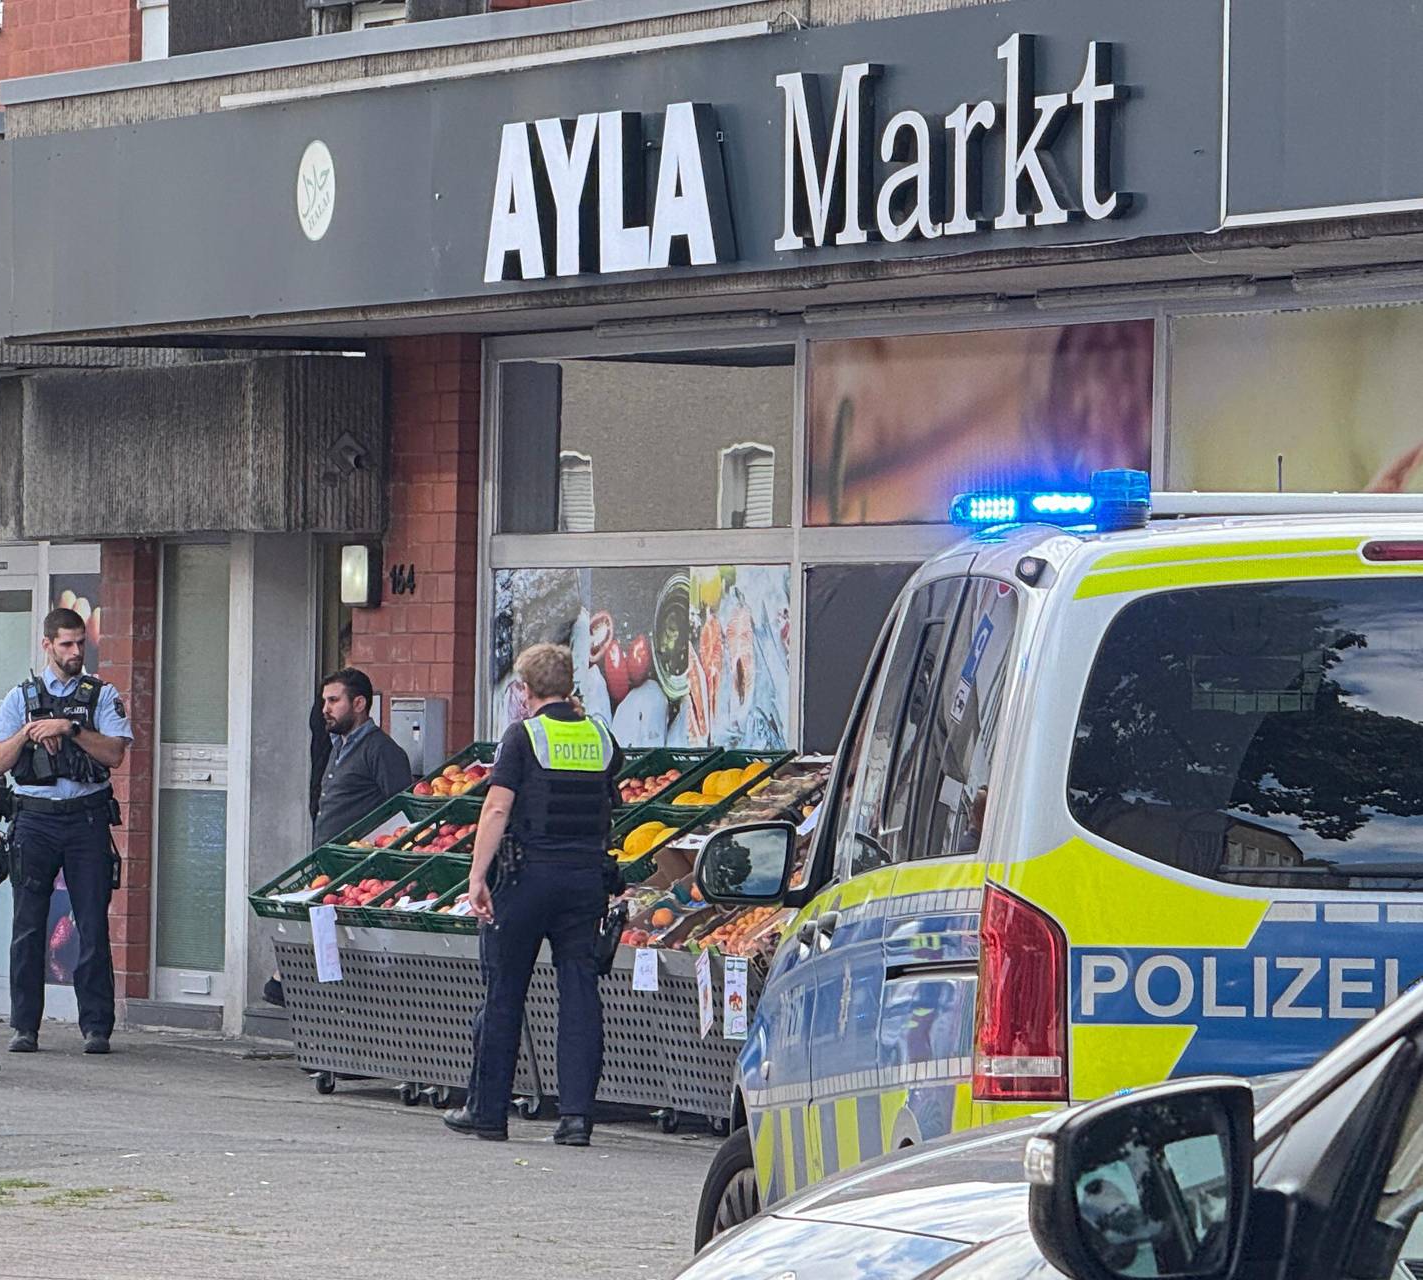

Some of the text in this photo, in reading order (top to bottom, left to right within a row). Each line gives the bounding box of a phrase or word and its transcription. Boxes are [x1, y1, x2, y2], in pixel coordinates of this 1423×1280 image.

[484, 33, 1118, 283] AYLA Markt
[390, 564, 416, 595] 164
[554, 744, 600, 760] POLIZEI
[1081, 955, 1399, 1018] POLIZEI
